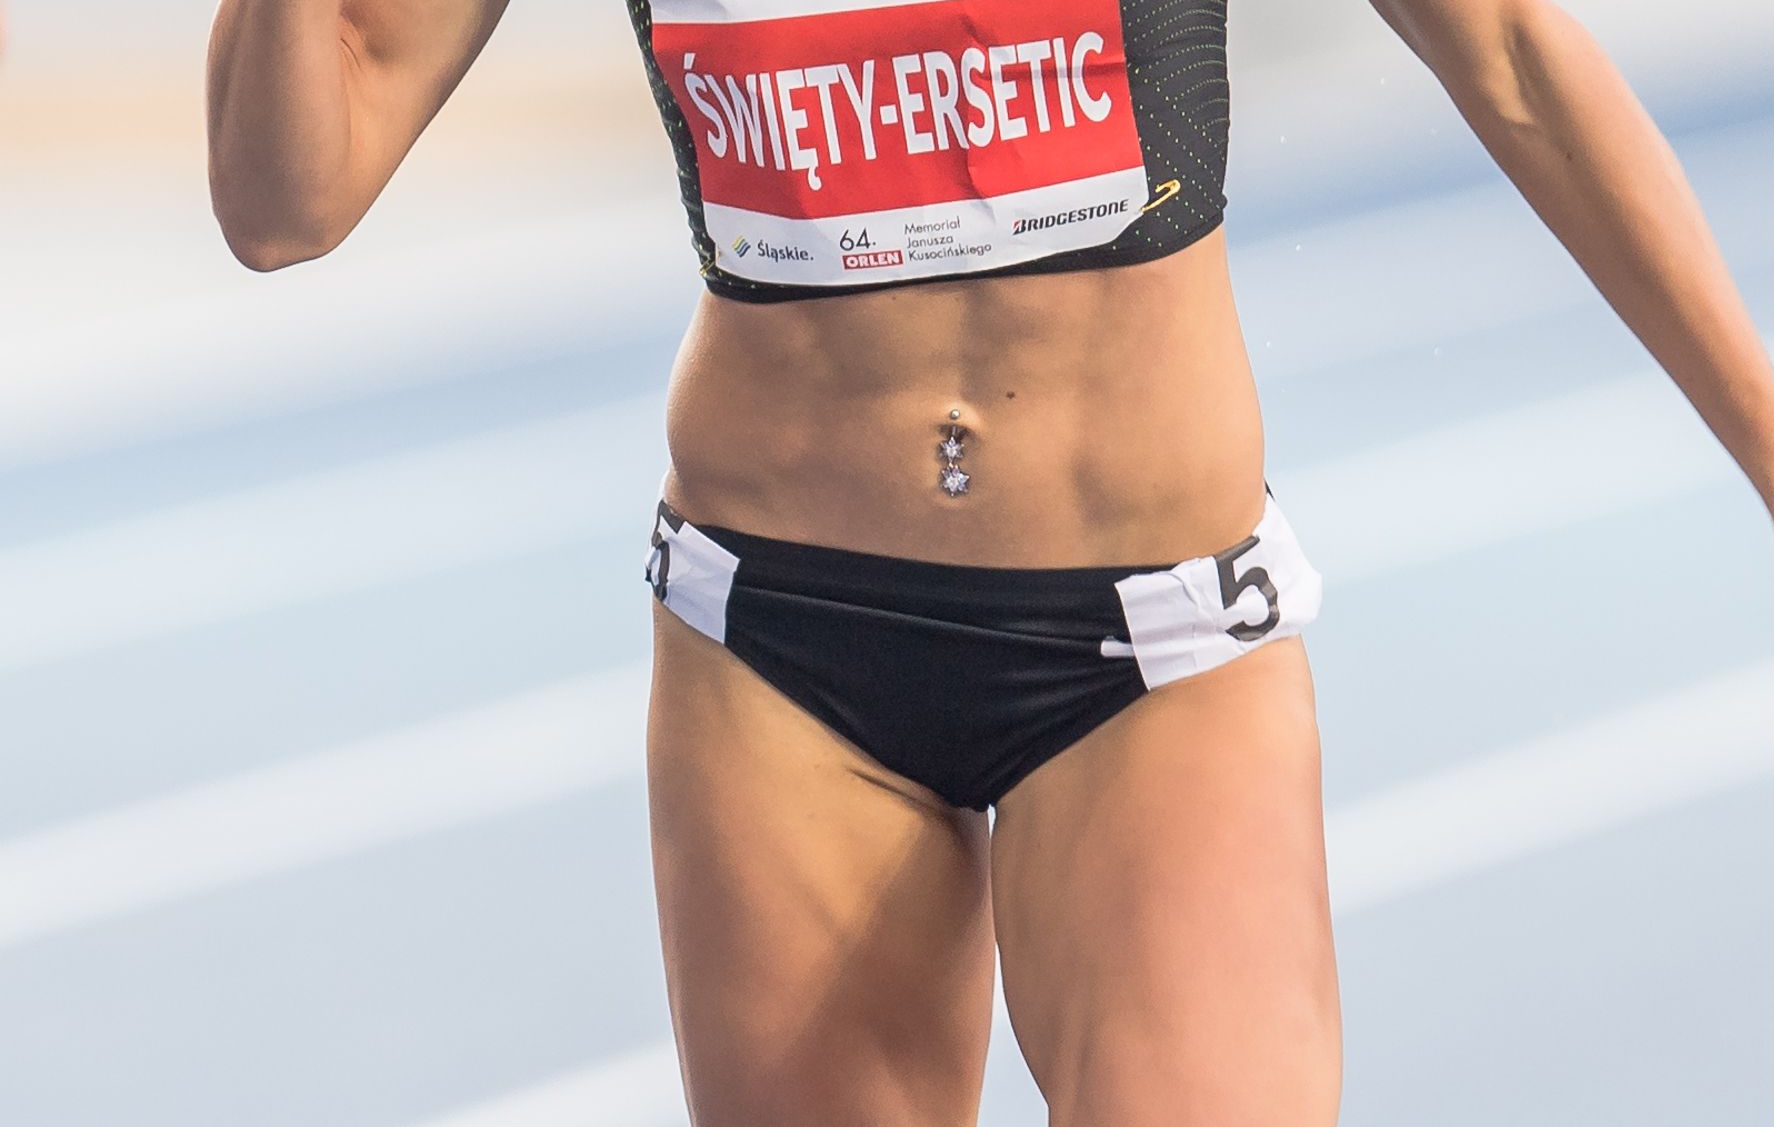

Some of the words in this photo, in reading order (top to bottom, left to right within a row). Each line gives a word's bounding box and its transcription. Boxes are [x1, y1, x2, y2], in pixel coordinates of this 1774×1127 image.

[684, 31, 1113, 191] ŚWIĘTY-ERSETIC
[1011, 198, 1129, 236] BRIDGESTONE
[906, 235, 954, 249] Janusza
[908, 243, 992, 262] Kusocińskiego
[845, 252, 901, 268] ORLEN
[1213, 535, 1280, 642] 5
